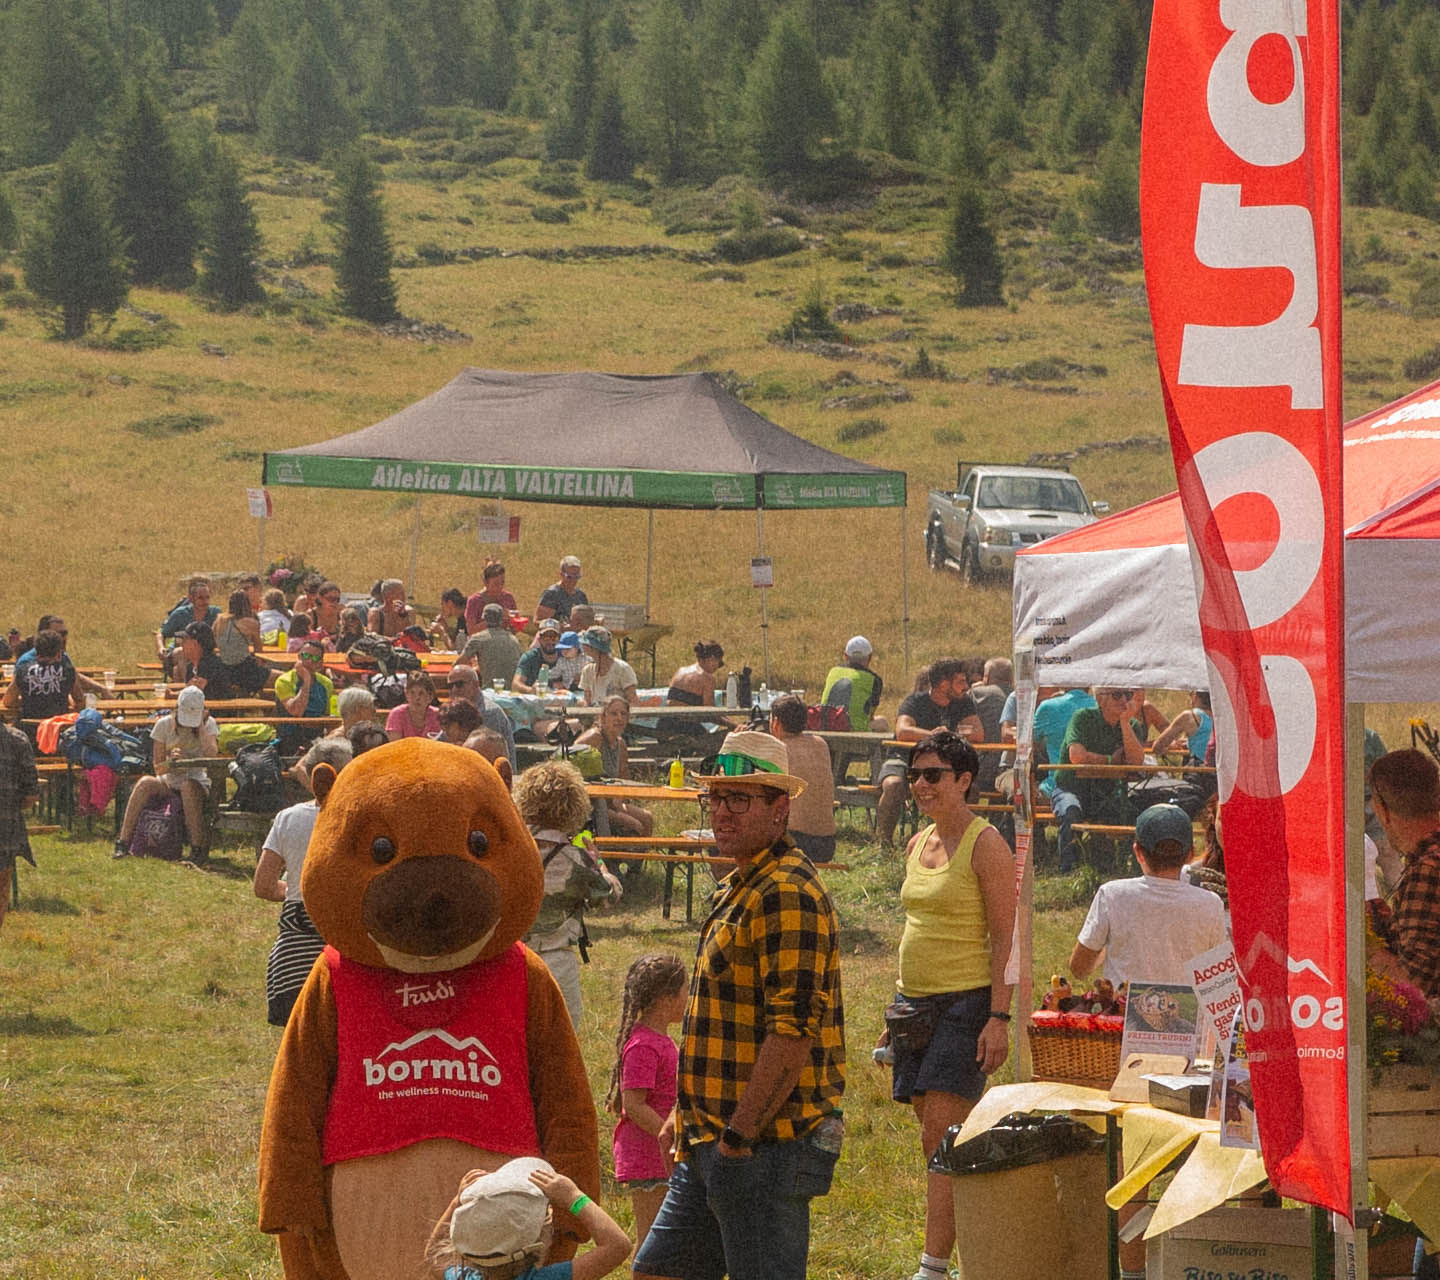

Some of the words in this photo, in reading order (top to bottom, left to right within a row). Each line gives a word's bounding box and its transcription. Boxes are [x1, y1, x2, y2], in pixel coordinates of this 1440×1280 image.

[371, 464, 451, 490] Atletica
[457, 469, 506, 493] ALTA
[514, 472, 635, 498] VALTELLINA
[395, 979, 455, 1008] Trudi
[363, 1051, 502, 1087] bormio
[378, 1090, 395, 1100] the
[396, 1086, 439, 1097] wellness
[442, 1086, 489, 1101] mountain
